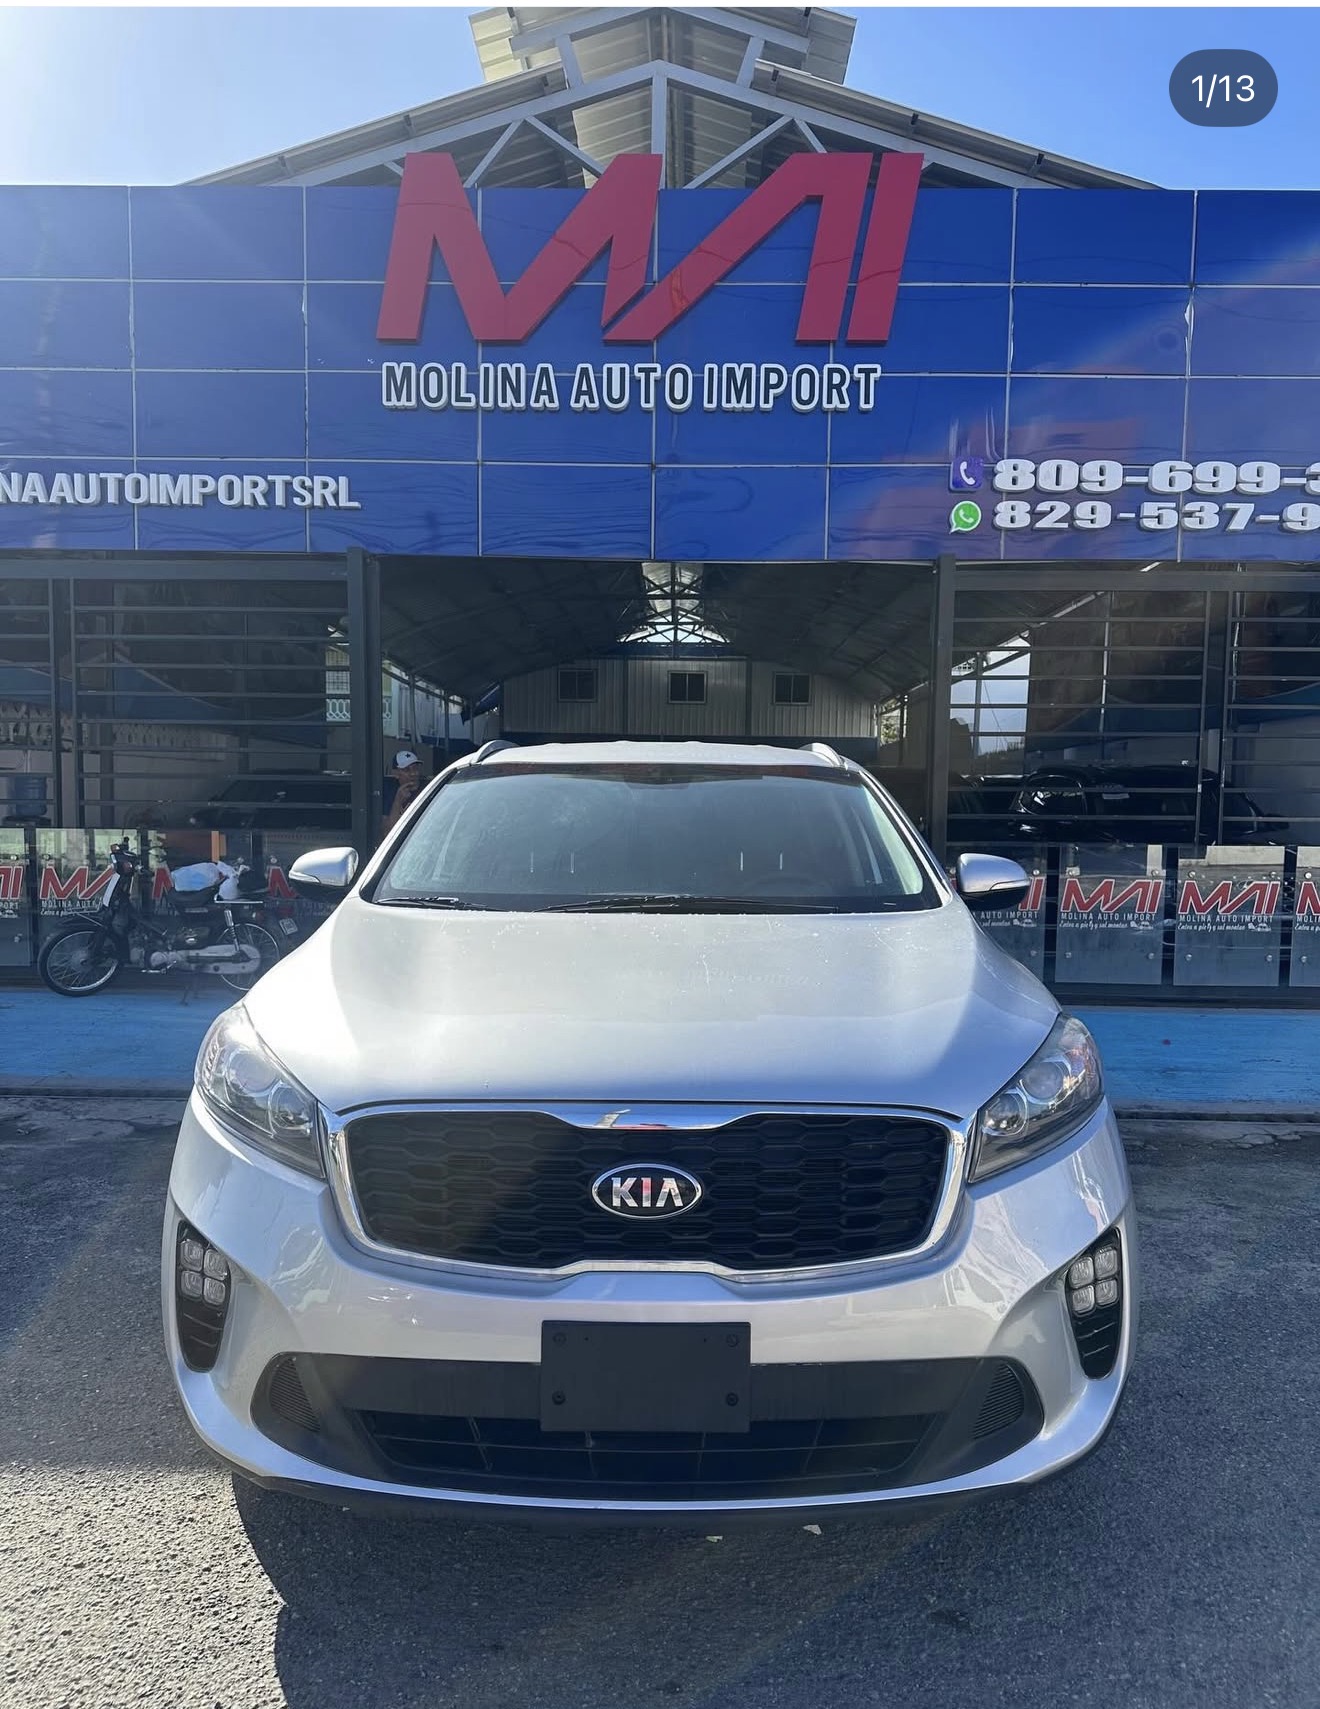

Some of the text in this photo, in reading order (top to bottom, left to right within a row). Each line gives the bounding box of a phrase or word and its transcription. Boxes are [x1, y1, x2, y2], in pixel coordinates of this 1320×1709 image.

[376, 152, 924, 344] MAI
[380, 362, 881, 413] MOLINA AUTO IMPORT
[41, 900, 72, 908] MOLINA
[980, 911, 1038, 919] AUTO IMPORT
[1061, 912, 1093, 920] MOLINA
[1123, 913, 1156, 921] IMPORT
[1179, 914, 1273, 923] MOLINA AUTO IMPORT
[611, 1177, 684, 1208] KIA
